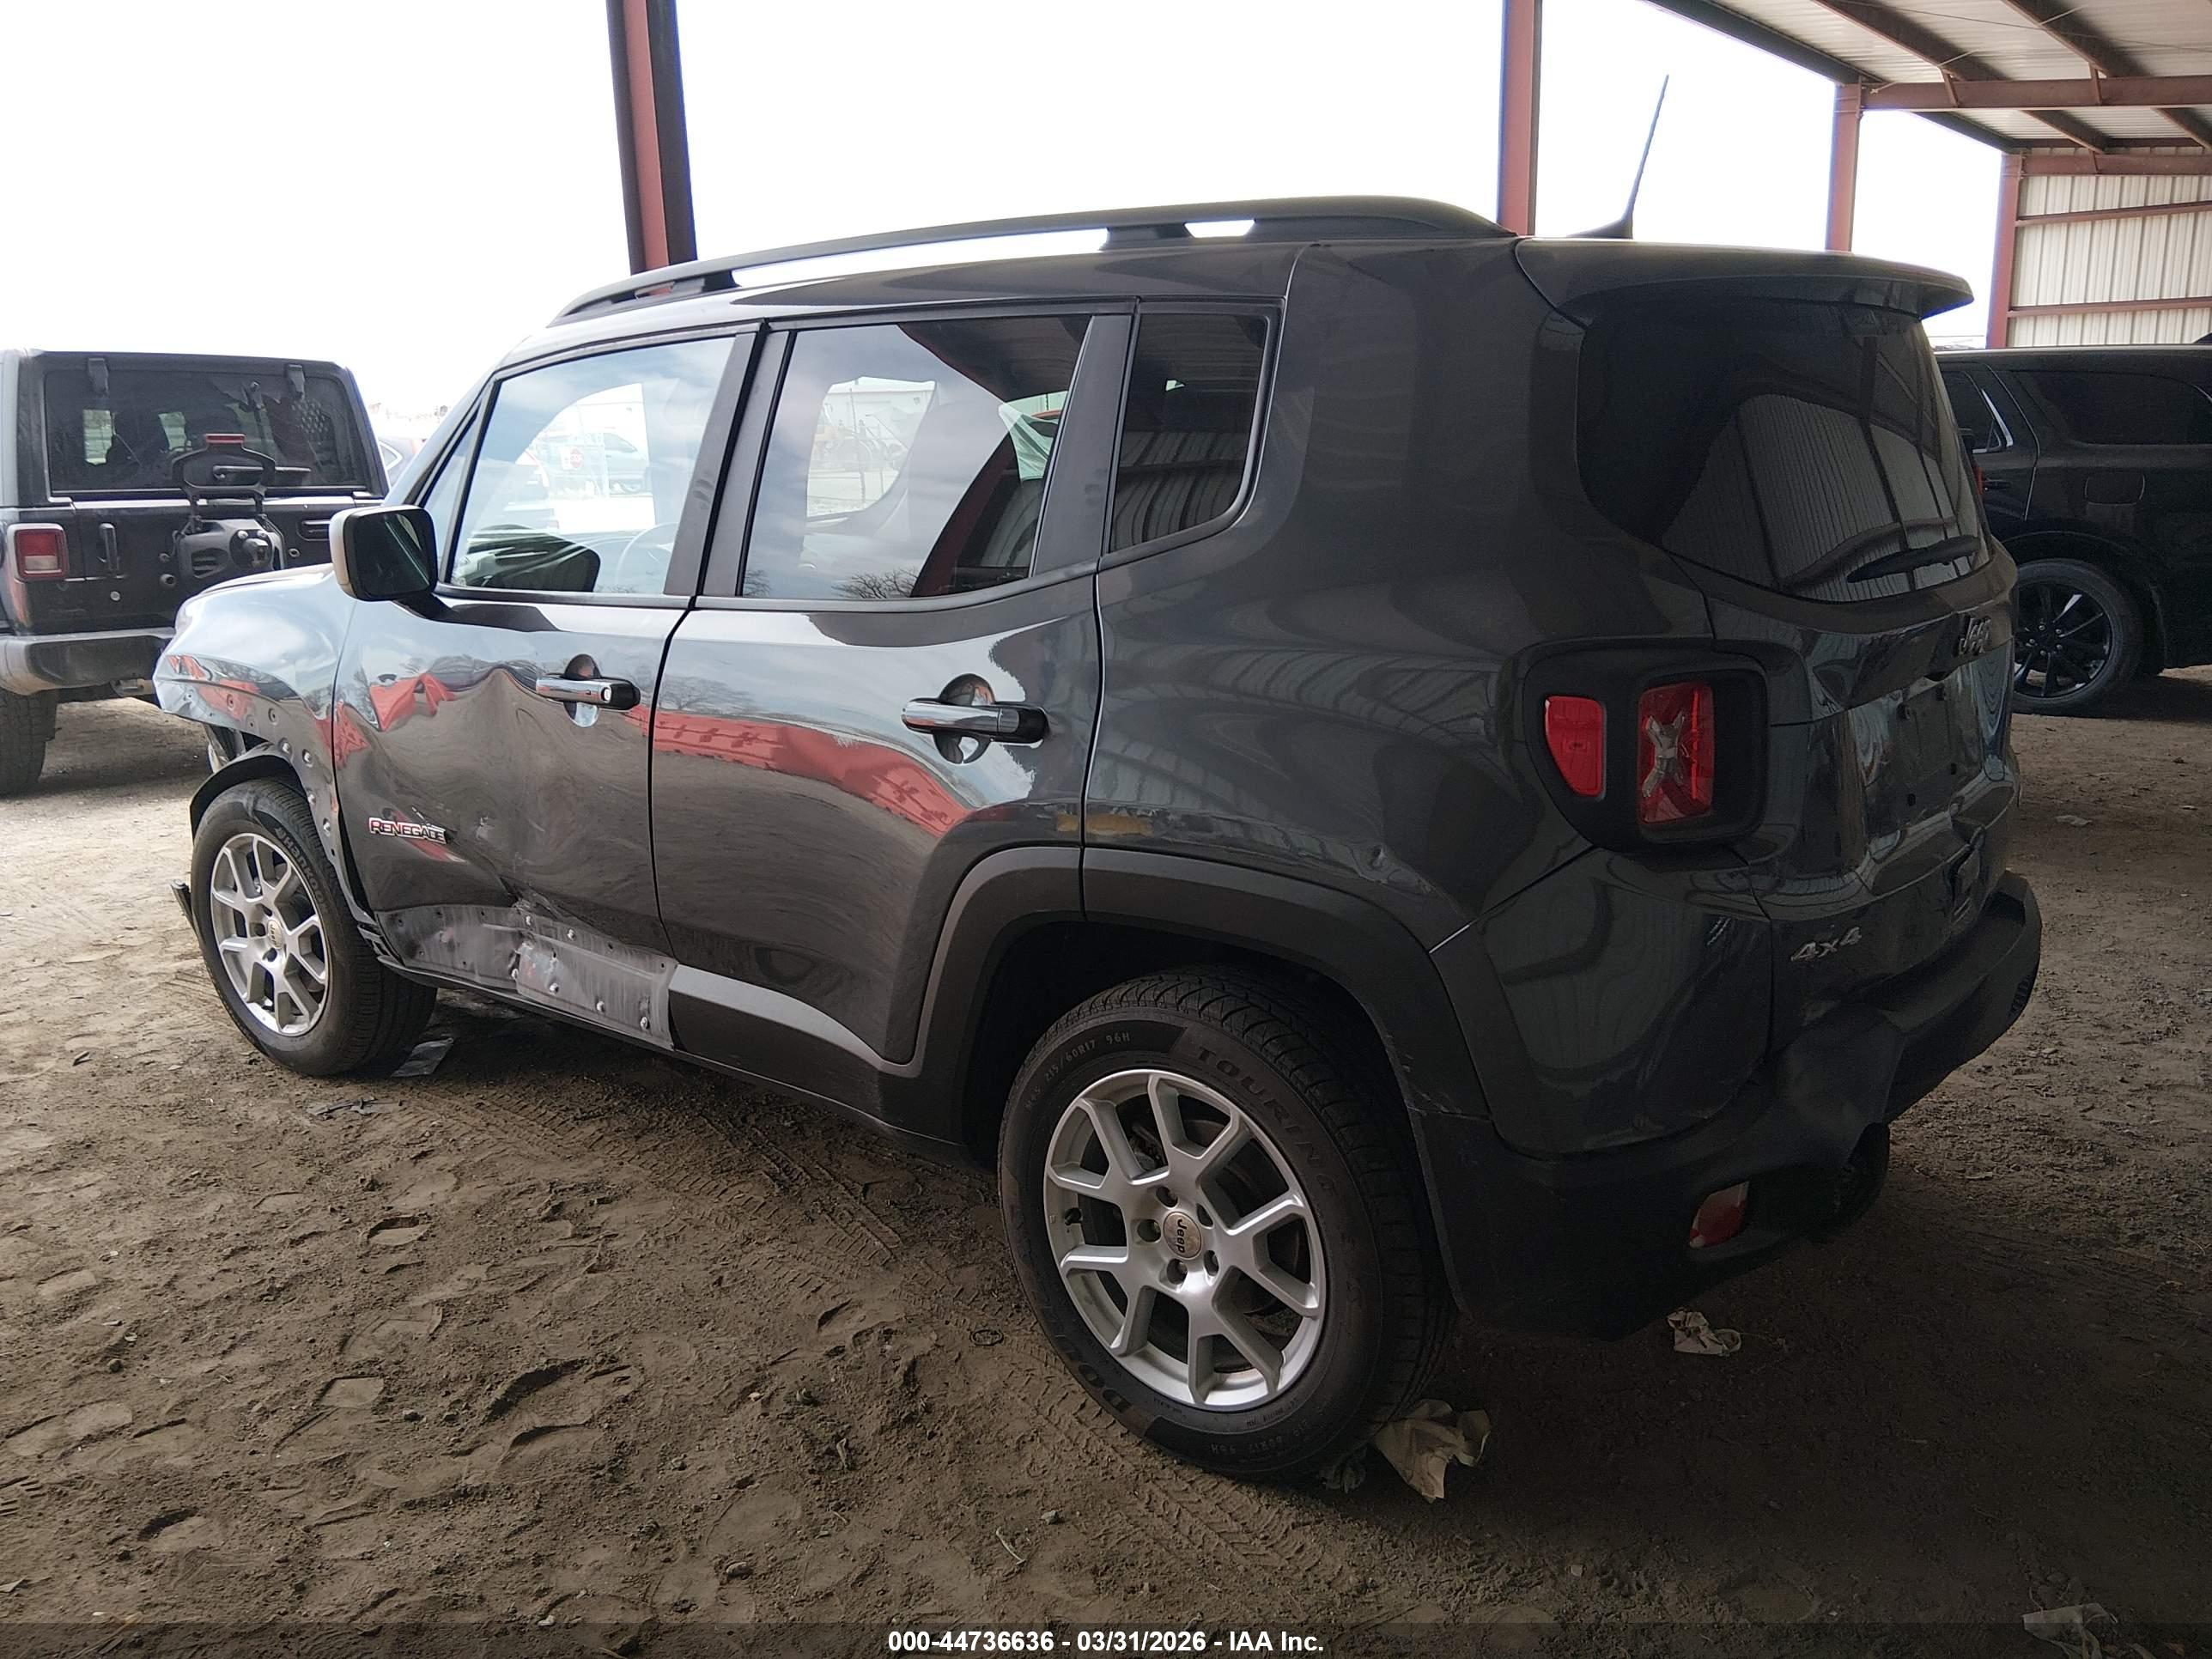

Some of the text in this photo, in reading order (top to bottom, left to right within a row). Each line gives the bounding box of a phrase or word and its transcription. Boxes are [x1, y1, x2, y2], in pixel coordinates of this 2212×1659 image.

[368, 817, 447, 845] RENEGADE
[1790, 927, 1863, 962] 4x4
[1043, 1038, 1097, 1083] 215/60R17
[1105, 1030, 1131, 1045] 96H
[1197, 1045, 1340, 1196] TOURING
[1176, 1218, 1188, 1254] Jeep
